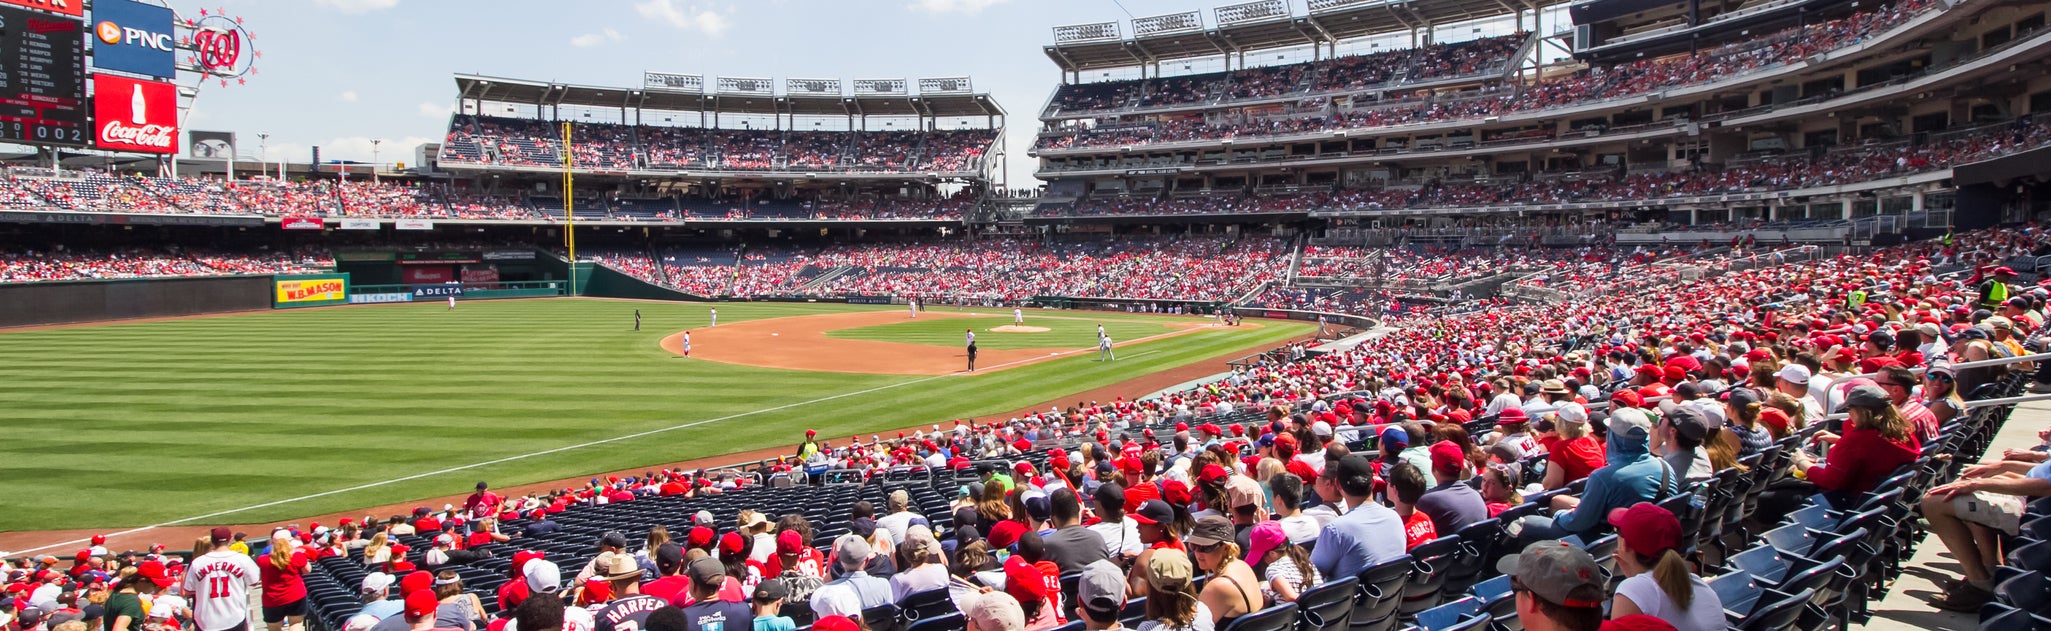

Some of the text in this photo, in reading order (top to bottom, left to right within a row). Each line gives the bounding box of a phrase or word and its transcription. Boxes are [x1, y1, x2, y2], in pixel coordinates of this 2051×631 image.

[123, 26, 173, 52] PNC
[101, 120, 175, 148] Coca-Cola
[426, 287, 461, 295] DELTA
[209, 576, 230, 599] 11
